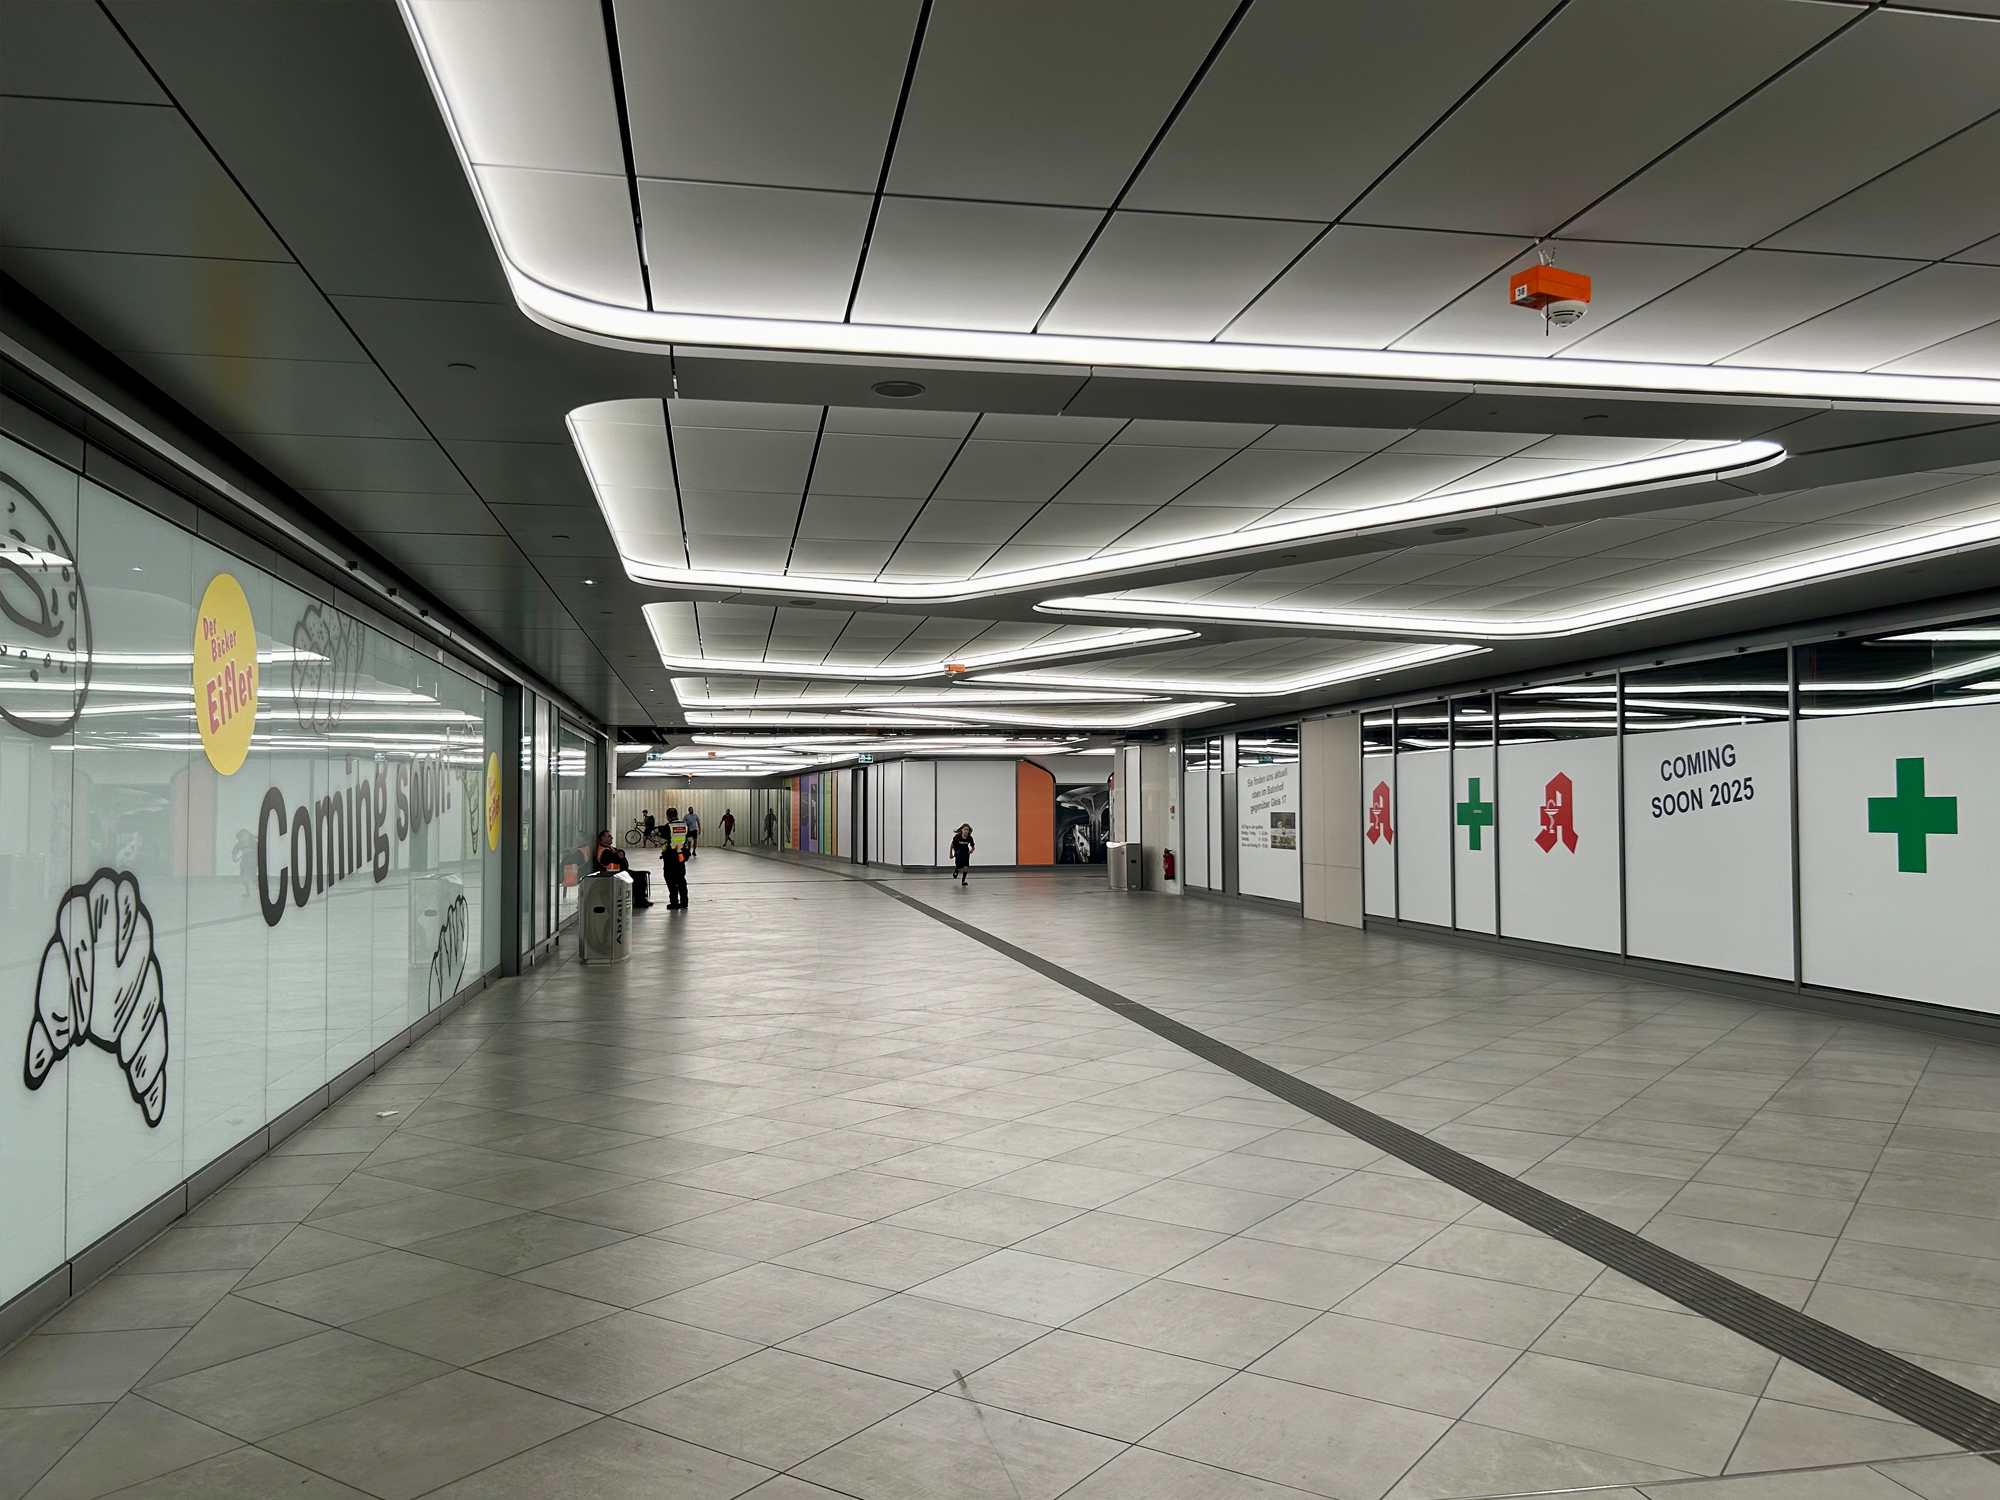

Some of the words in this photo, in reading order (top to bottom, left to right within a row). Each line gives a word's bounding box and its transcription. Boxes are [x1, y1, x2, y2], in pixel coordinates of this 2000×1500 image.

[1516, 286, 1525, 297] 38
[202, 617, 217, 640] Der
[211, 629, 237, 662] Bäcker
[206, 660, 253, 735] Eifler
[1254, 775, 1266, 786] finden
[1266, 773, 1274, 782] uns
[1274, 767, 1287, 780] aktuell
[1660, 743, 1736, 782] COMING
[1267, 782, 1284, 794] Bahnhof
[1270, 797, 1281, 807] Gleis
[1651, 786, 1703, 819] SOON
[1709, 777, 1754, 807] 2025
[258, 754, 390, 927] Coming
[396, 726, 451, 842] soon!
